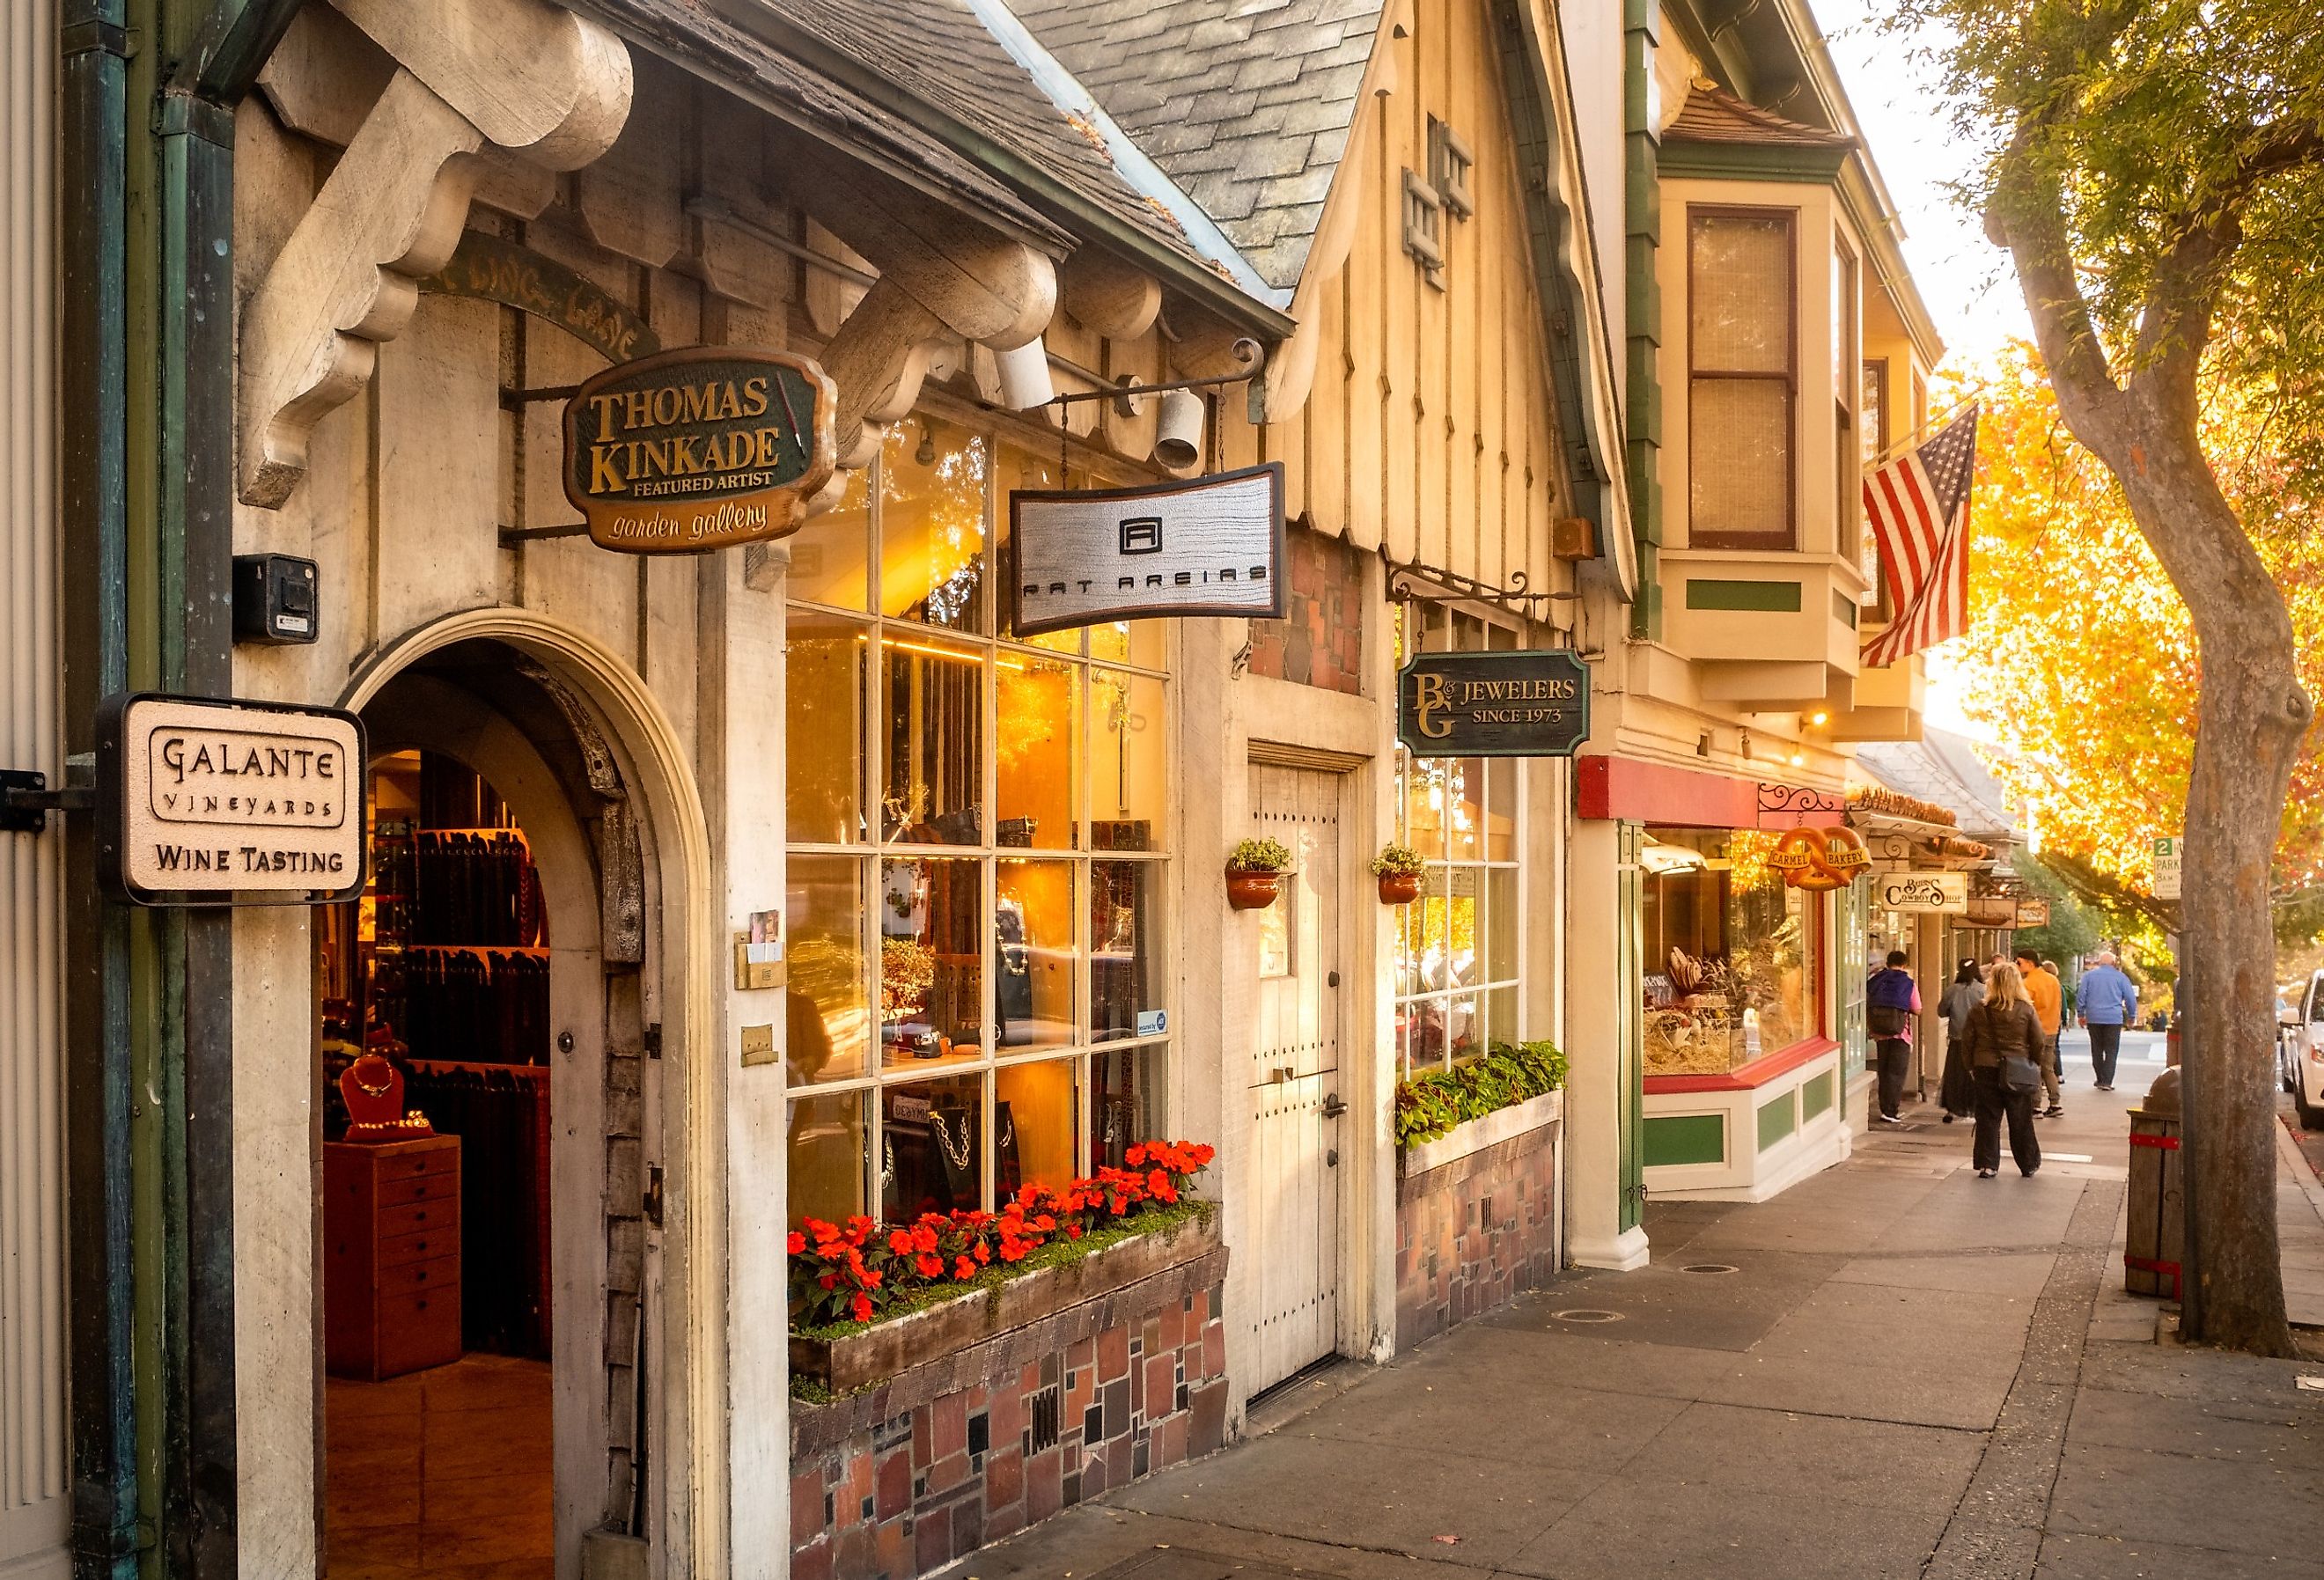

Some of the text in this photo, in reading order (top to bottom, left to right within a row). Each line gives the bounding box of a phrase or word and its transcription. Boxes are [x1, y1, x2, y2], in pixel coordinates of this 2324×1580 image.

[590, 377, 768, 443] THOMAS
[589, 427, 779, 494] KINKADE
[634, 471, 774, 497] FEATURED ARTIST
[608, 502, 767, 540] garden gallery
[1023, 565, 1266, 597] PAT AREIAS
[1460, 679, 1575, 705] JEWELERS
[1473, 709, 1562, 724] SINCE 1973
[163, 738, 334, 783] GALANTE
[164, 793, 331, 816] VINEYARDS
[155, 843, 343, 872] WINE TASTING
[1772, 851, 1864, 865] CARMEL BAKERY
[2158, 841, 2168, 854] 2
[2156, 859, 2180, 871] PARK
